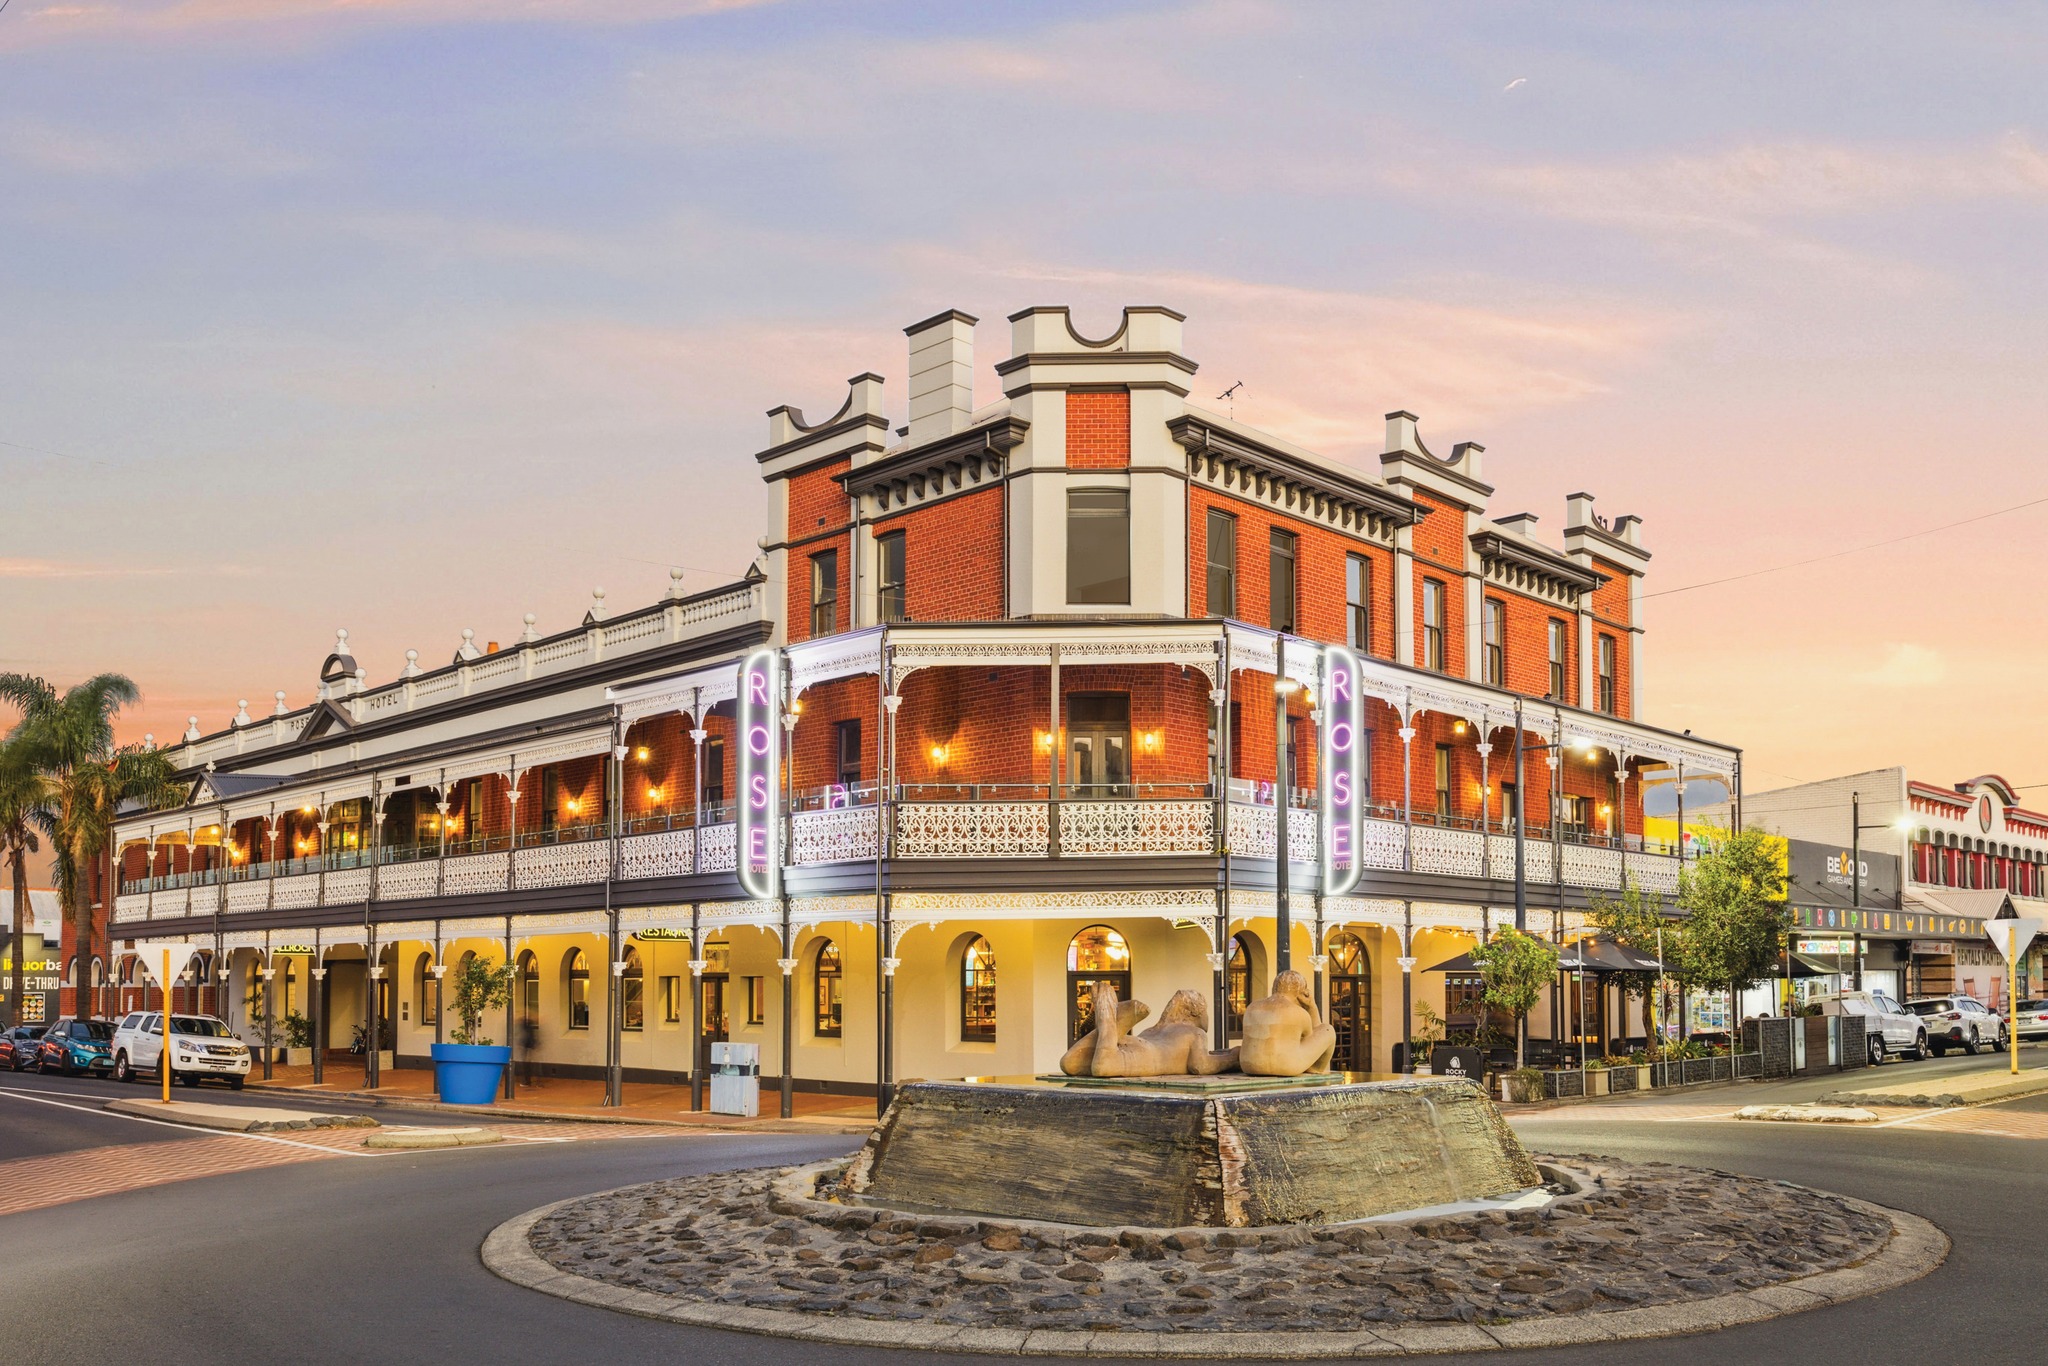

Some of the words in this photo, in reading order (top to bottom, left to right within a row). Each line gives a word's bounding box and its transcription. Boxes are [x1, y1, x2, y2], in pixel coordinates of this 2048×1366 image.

[371, 693, 398, 711] HOTEL
[749, 670, 769, 861] ROSE
[1330, 669, 1352, 858] ROSE
